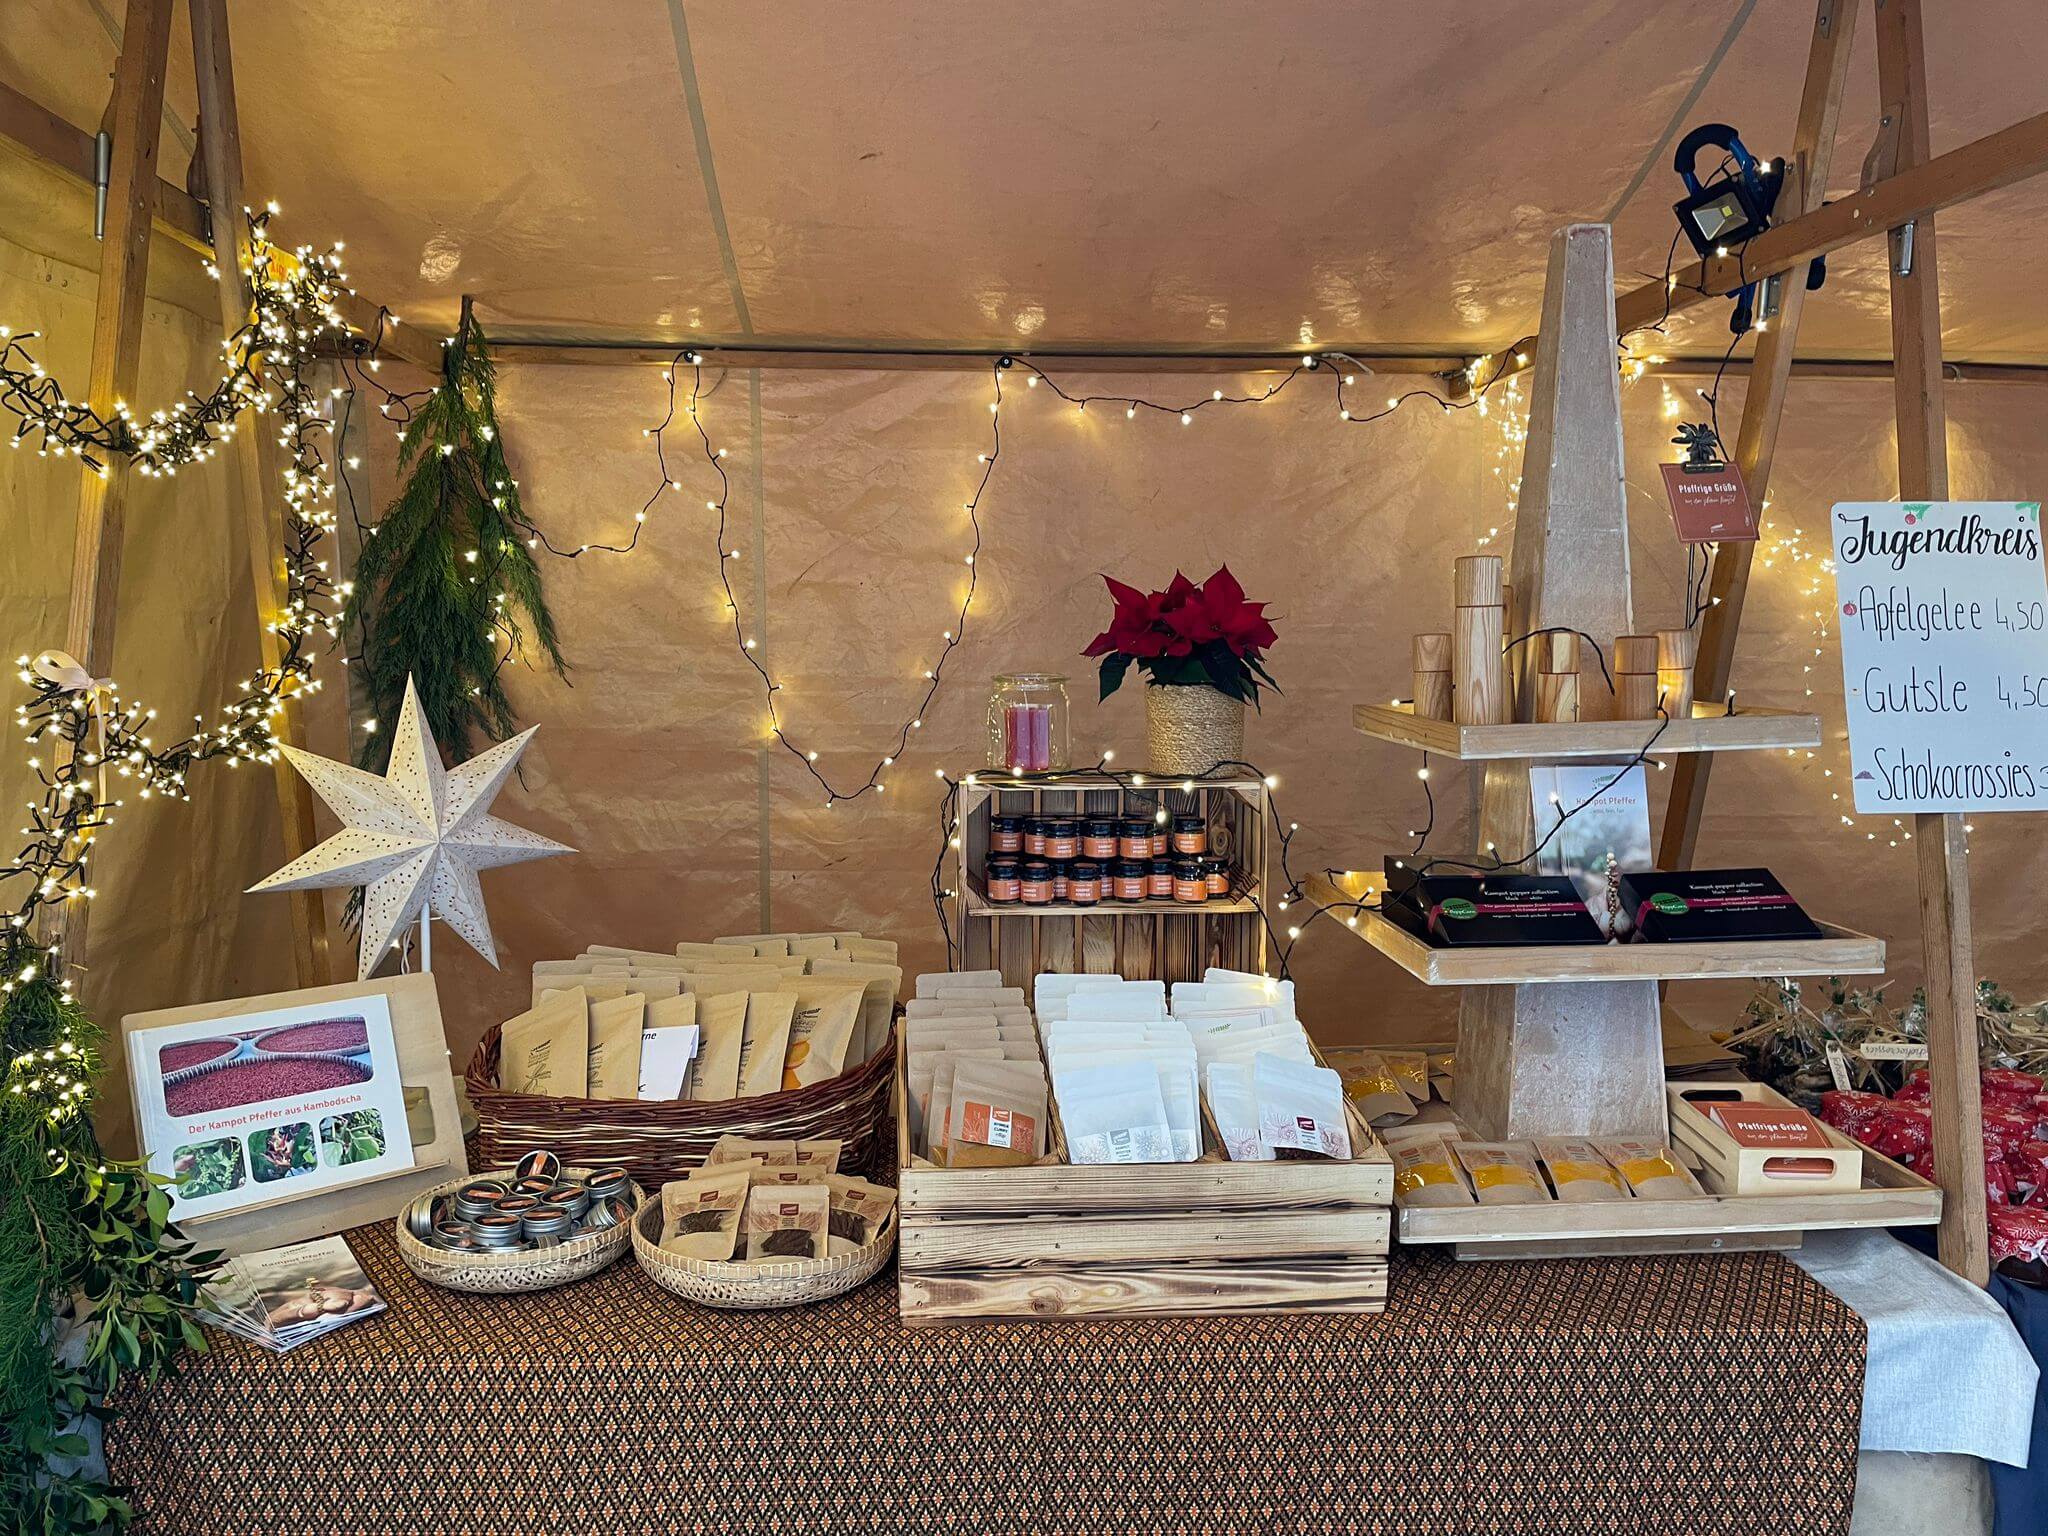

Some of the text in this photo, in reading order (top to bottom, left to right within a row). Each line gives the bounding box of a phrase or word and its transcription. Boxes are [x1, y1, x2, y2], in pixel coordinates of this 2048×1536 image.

[1679, 483, 1737, 494] Pfeffrige Grüße
[1838, 514, 2038, 570] Jugendkreis
[1859, 585, 2044, 641] Apfelgelee 4,50
[1864, 665, 2048, 713] Gutsle 4,50
[1874, 747, 2036, 801] Schokocrossies
[188, 1094, 363, 1135] Der Kampot Pfeffer aus Kambodscha
[1737, 1122, 1808, 1132] Pfeffrige Grüße
